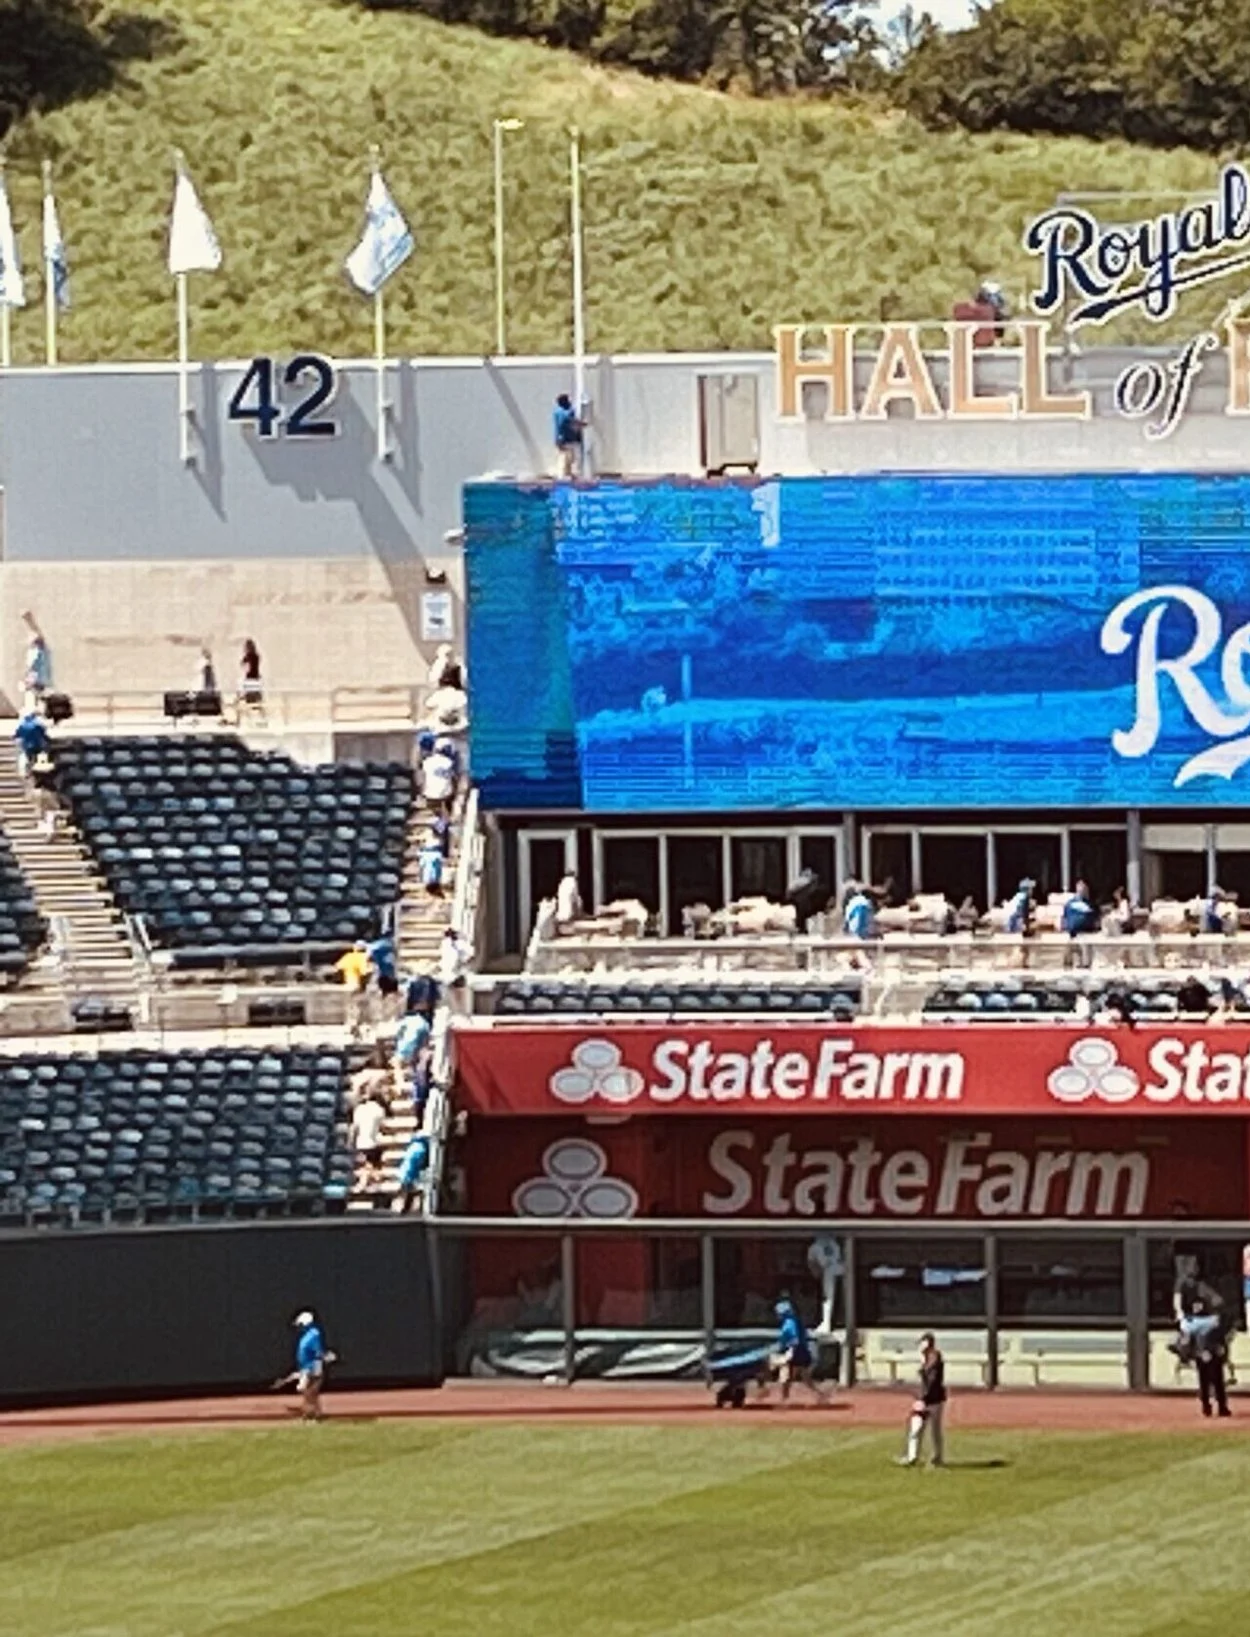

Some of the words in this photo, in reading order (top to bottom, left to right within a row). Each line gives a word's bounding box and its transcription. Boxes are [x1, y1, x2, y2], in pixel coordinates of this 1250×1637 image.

[228, 353, 342, 441] 42
[774, 321, 1091, 422] HALL
[1116, 333, 1219, 440] of
